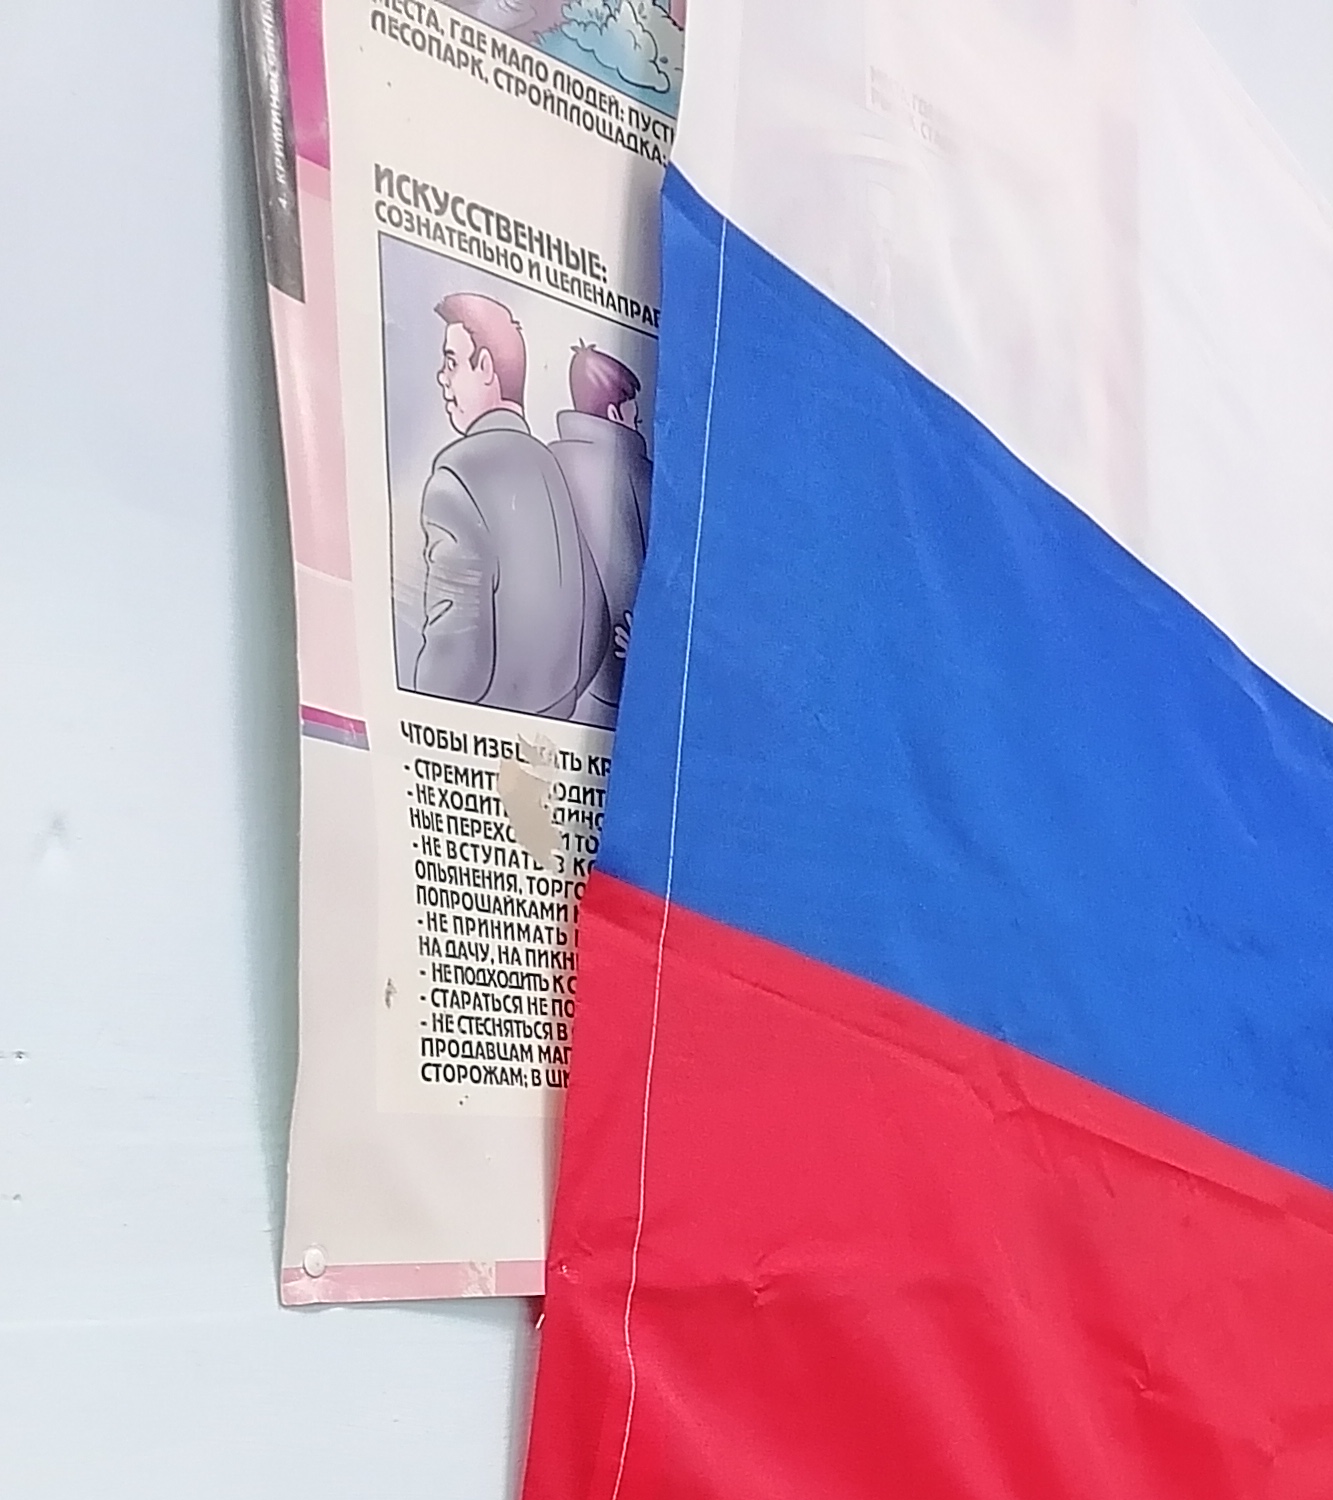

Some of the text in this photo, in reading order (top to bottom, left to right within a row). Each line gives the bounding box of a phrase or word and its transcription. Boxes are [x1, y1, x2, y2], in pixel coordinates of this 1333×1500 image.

[371, 9, 489, 85] ЛЕСОПАРК,
[372, 0, 445, 37] ЕСТА,
[450, 17, 487, 54] ГДЕ
[490, 38, 548, 84] МАЛО
[553, 69, 625, 122] ЛЮДЕЙ:
[373, 162, 609, 284] ИСКУССТВЕННЫЕ:
[374, 200, 524, 275] СОЗНАТЕЛЬНО
[527, 257, 542, 283] И
[400, 720, 468, 751] ЧТОБЫ
[415, 783, 436, 806] НЕ
[409, 807, 444, 833] НЫЕ
[421, 835, 442, 858] НЕ
[414, 859, 523, 896] ОПЬЯНЕНИЯ,
[416, 884, 568, 923] ПОПРОШАЙКАМИ
[426, 911, 448, 933] НЕ
[453, 915, 568, 946] ПРИНИМАТЬ
[418, 935, 579, 971] НА ДАЧУ, НА ПИКН
[431, 962, 452, 983] НЕ
[453, 965, 550, 992] ПОДХОДИТЬ
[552, 975, 565, 994] К
[430, 987, 524, 1015] СТАРАТЬСЯ
[527, 996, 548, 1016] НЕ
[431, 1013, 455, 1034] НЕ
[457, 1015, 554, 1041] СТЕСНЯТЬСЯ
[556, 1022, 568, 1041] В
[420, 1037, 534, 1063] ПРОДАВЦАМ
[420, 1062, 528, 1088] СТОРОЖАМ;
[531, 1068, 542, 1087] В
